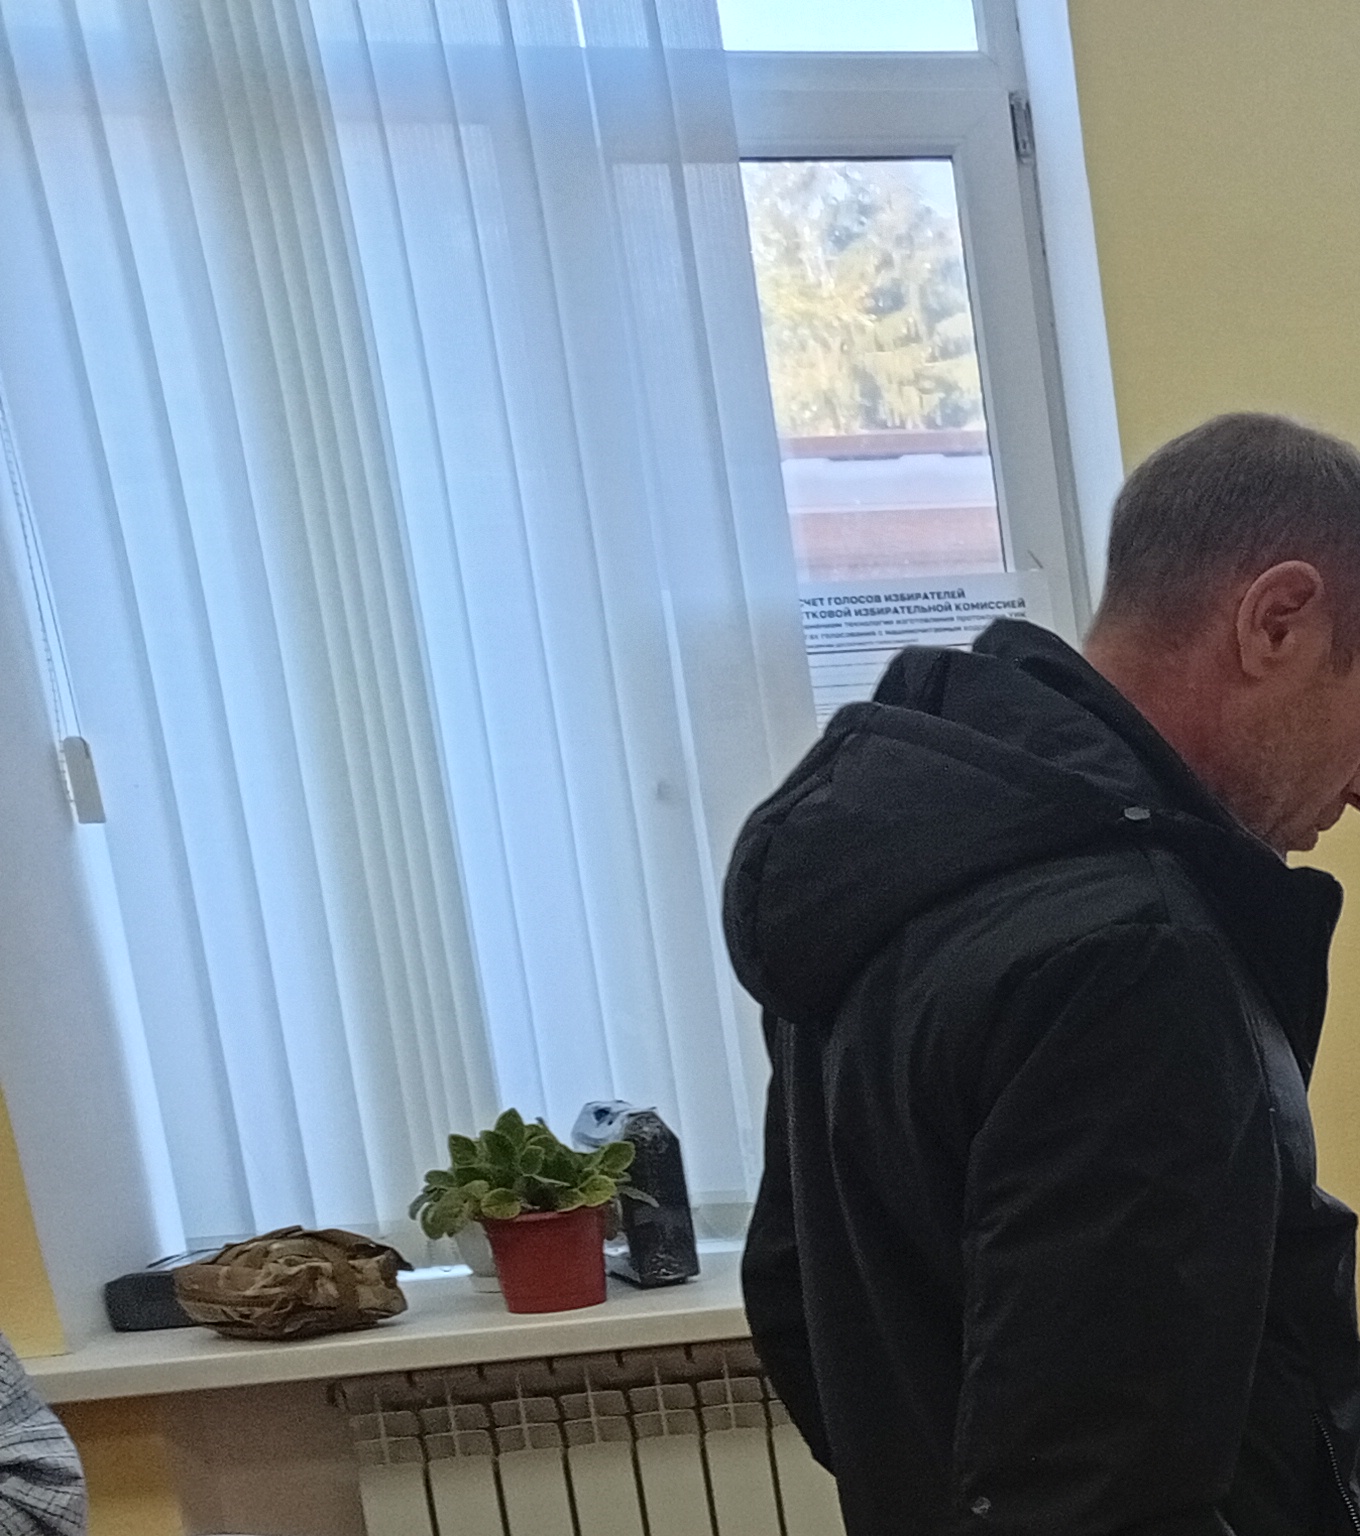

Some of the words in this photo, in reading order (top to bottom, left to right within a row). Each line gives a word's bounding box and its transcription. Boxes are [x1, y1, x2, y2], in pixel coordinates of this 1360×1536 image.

[827, 594, 882, 606] ГОЛОСОВ
[884, 588, 966, 604] ИЗБИРАТЕЛЕЙ
[854, 602, 953, 618] ИЗБИРАТЕЛЬНОЙ
[955, 597, 1026, 611] КОМИССИЕЙ
